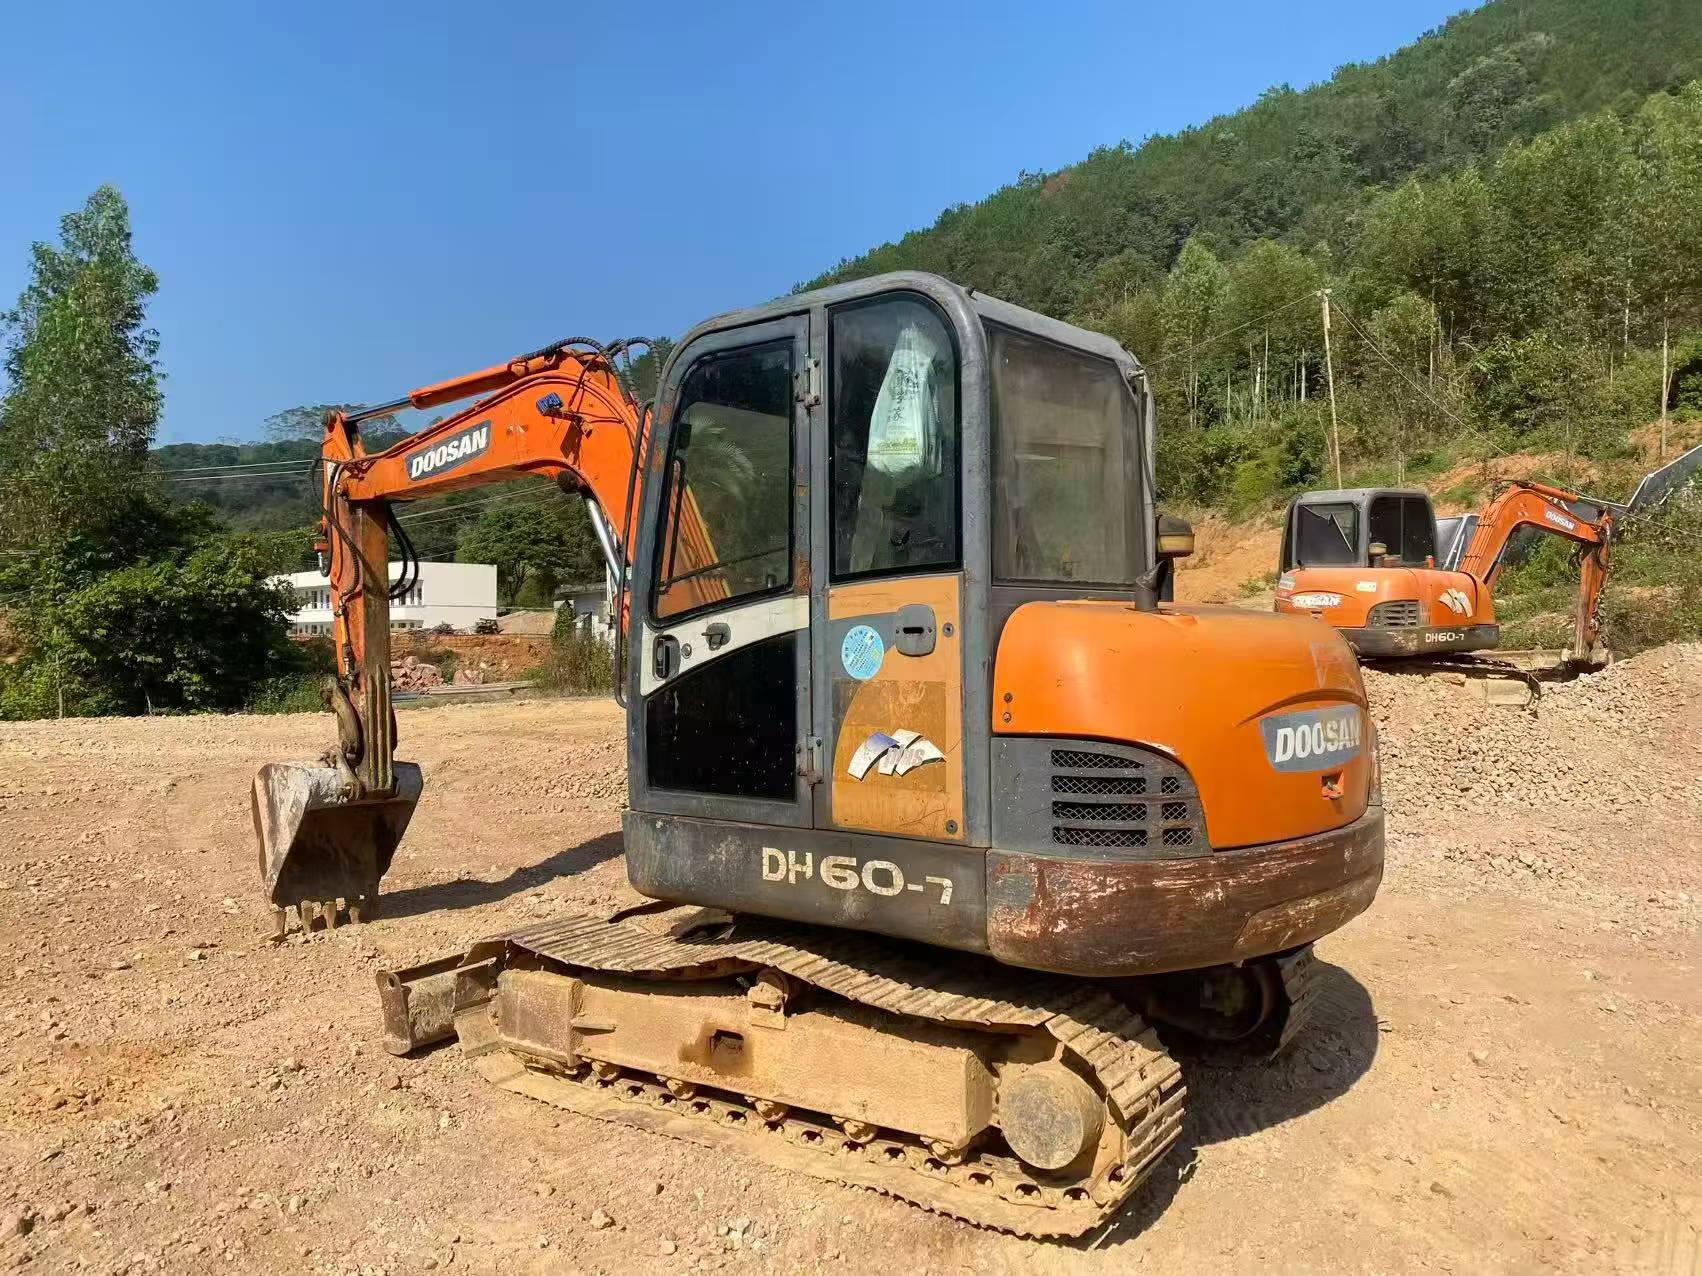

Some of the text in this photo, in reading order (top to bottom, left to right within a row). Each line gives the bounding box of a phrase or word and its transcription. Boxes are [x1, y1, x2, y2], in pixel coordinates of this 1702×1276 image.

[411, 427, 488, 478] DOOSAN
[1425, 632, 1465, 643] DH60-7
[1274, 716, 1360, 763] DOOSAN
